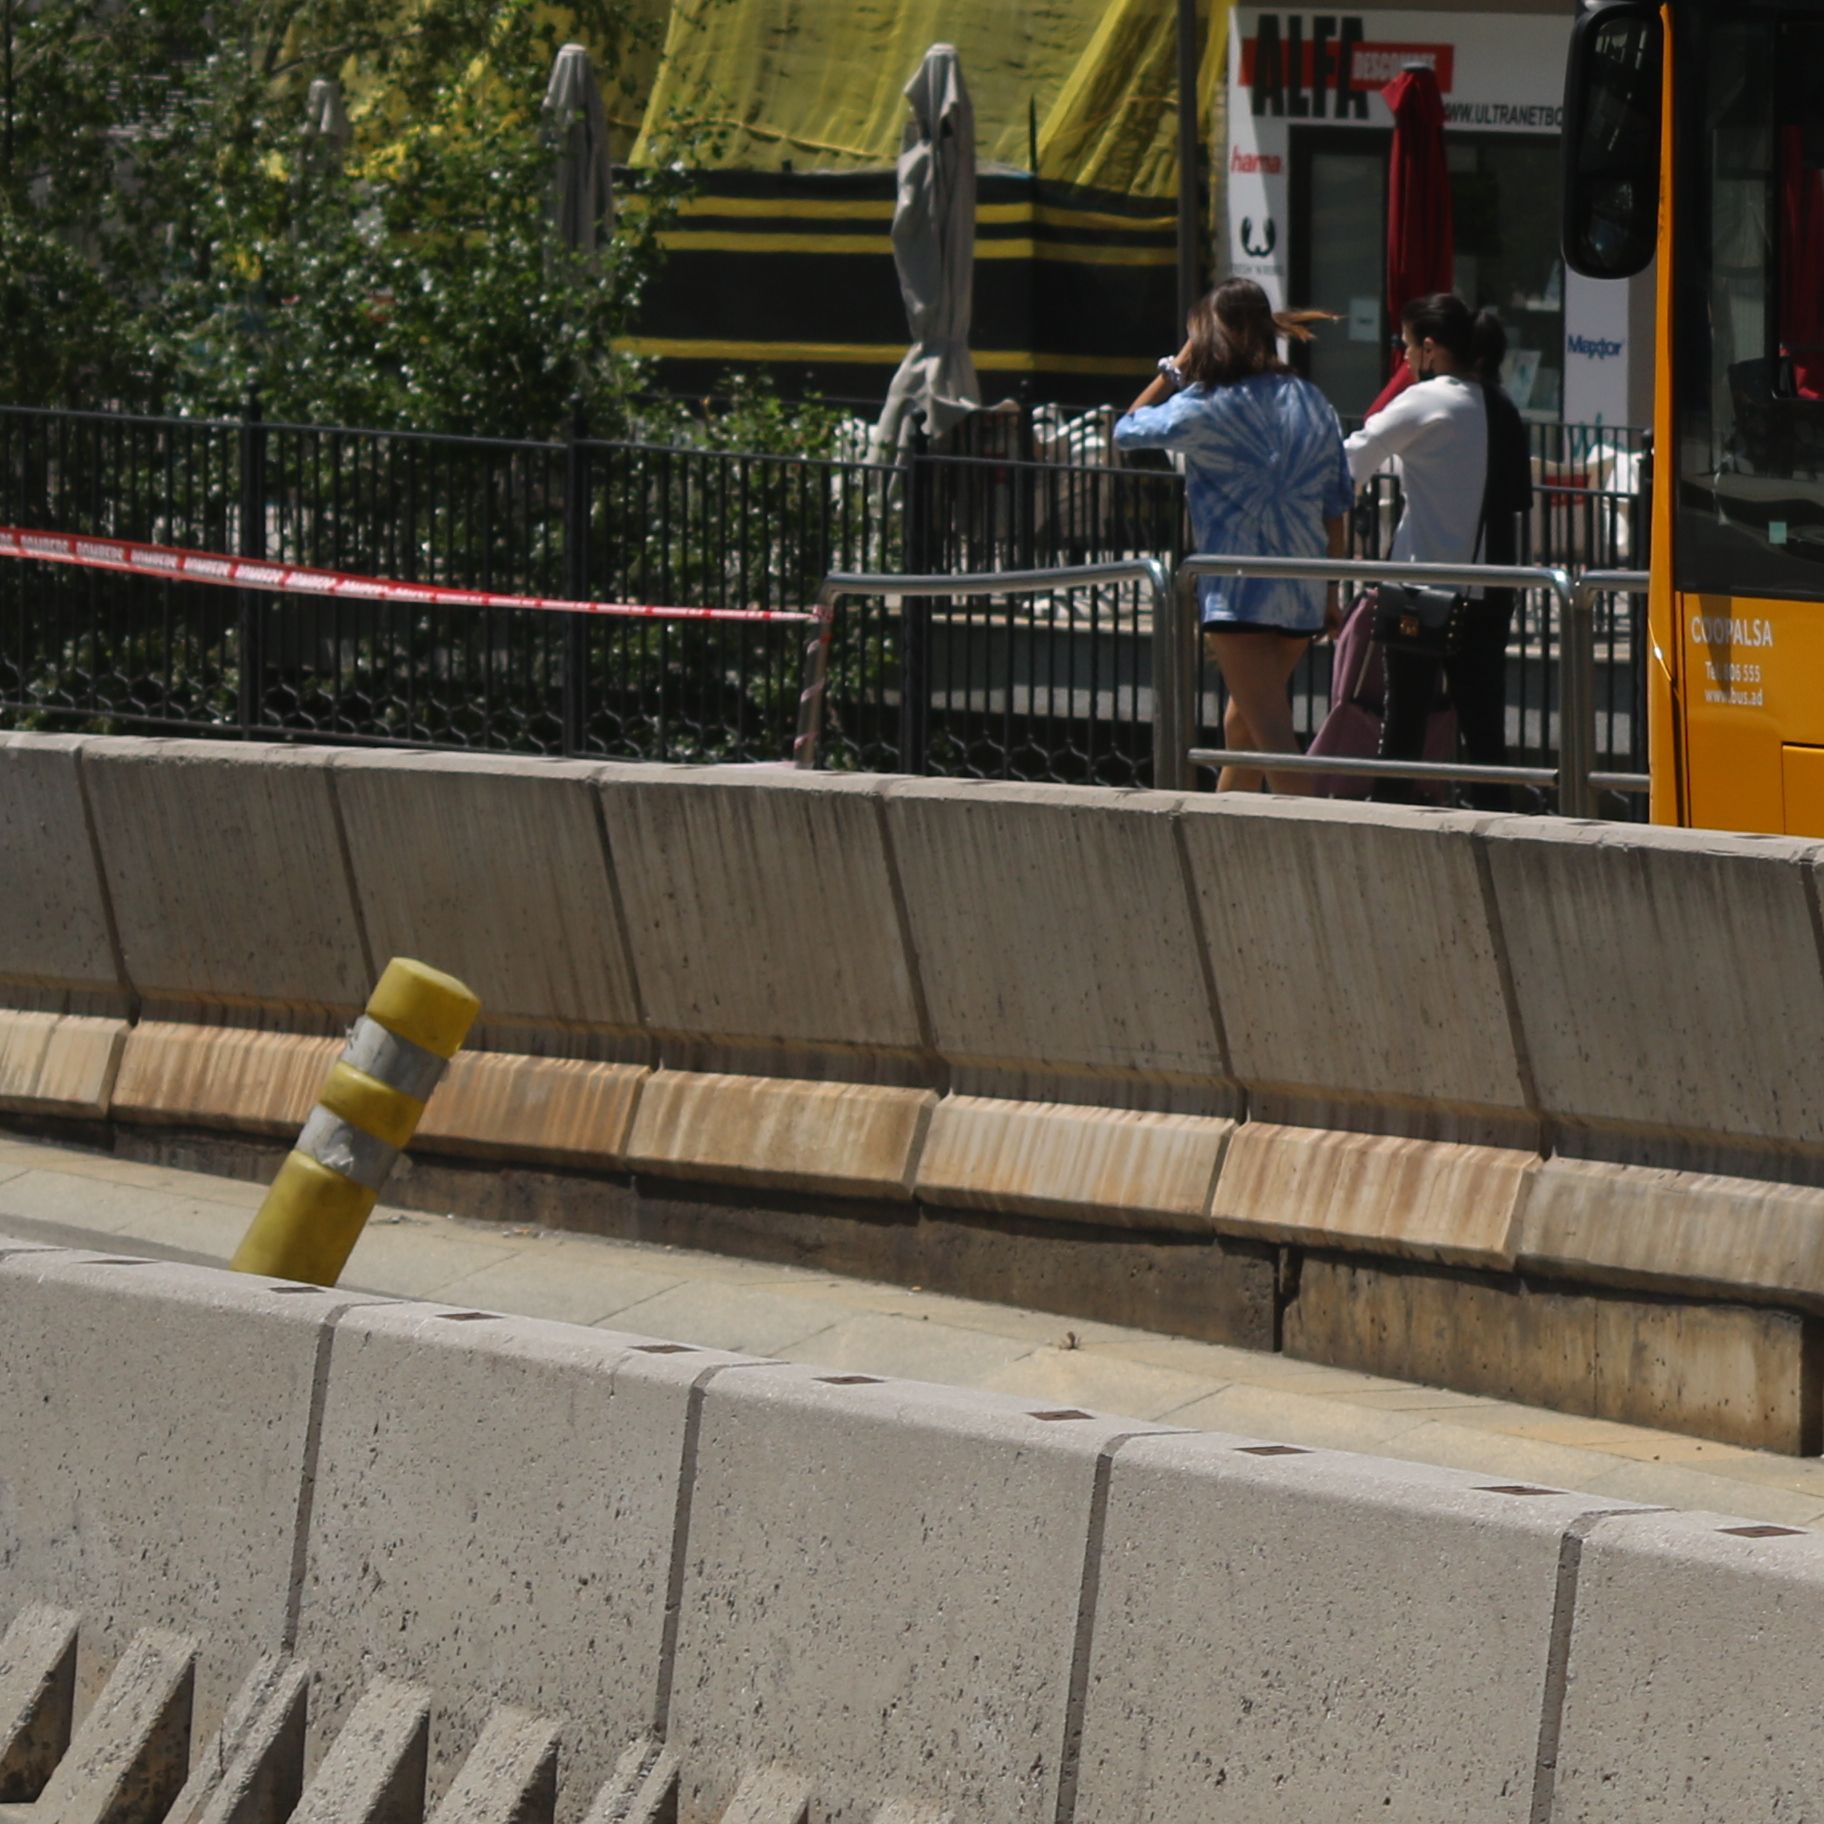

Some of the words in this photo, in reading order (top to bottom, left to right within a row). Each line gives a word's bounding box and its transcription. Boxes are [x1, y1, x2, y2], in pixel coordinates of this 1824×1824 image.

[1252, 14, 1369, 119] ALFA
[1231, 145, 1281, 174] hama
[1691, 616, 1773, 647] COOPALSA
[1743, 664, 1761, 683] 555
